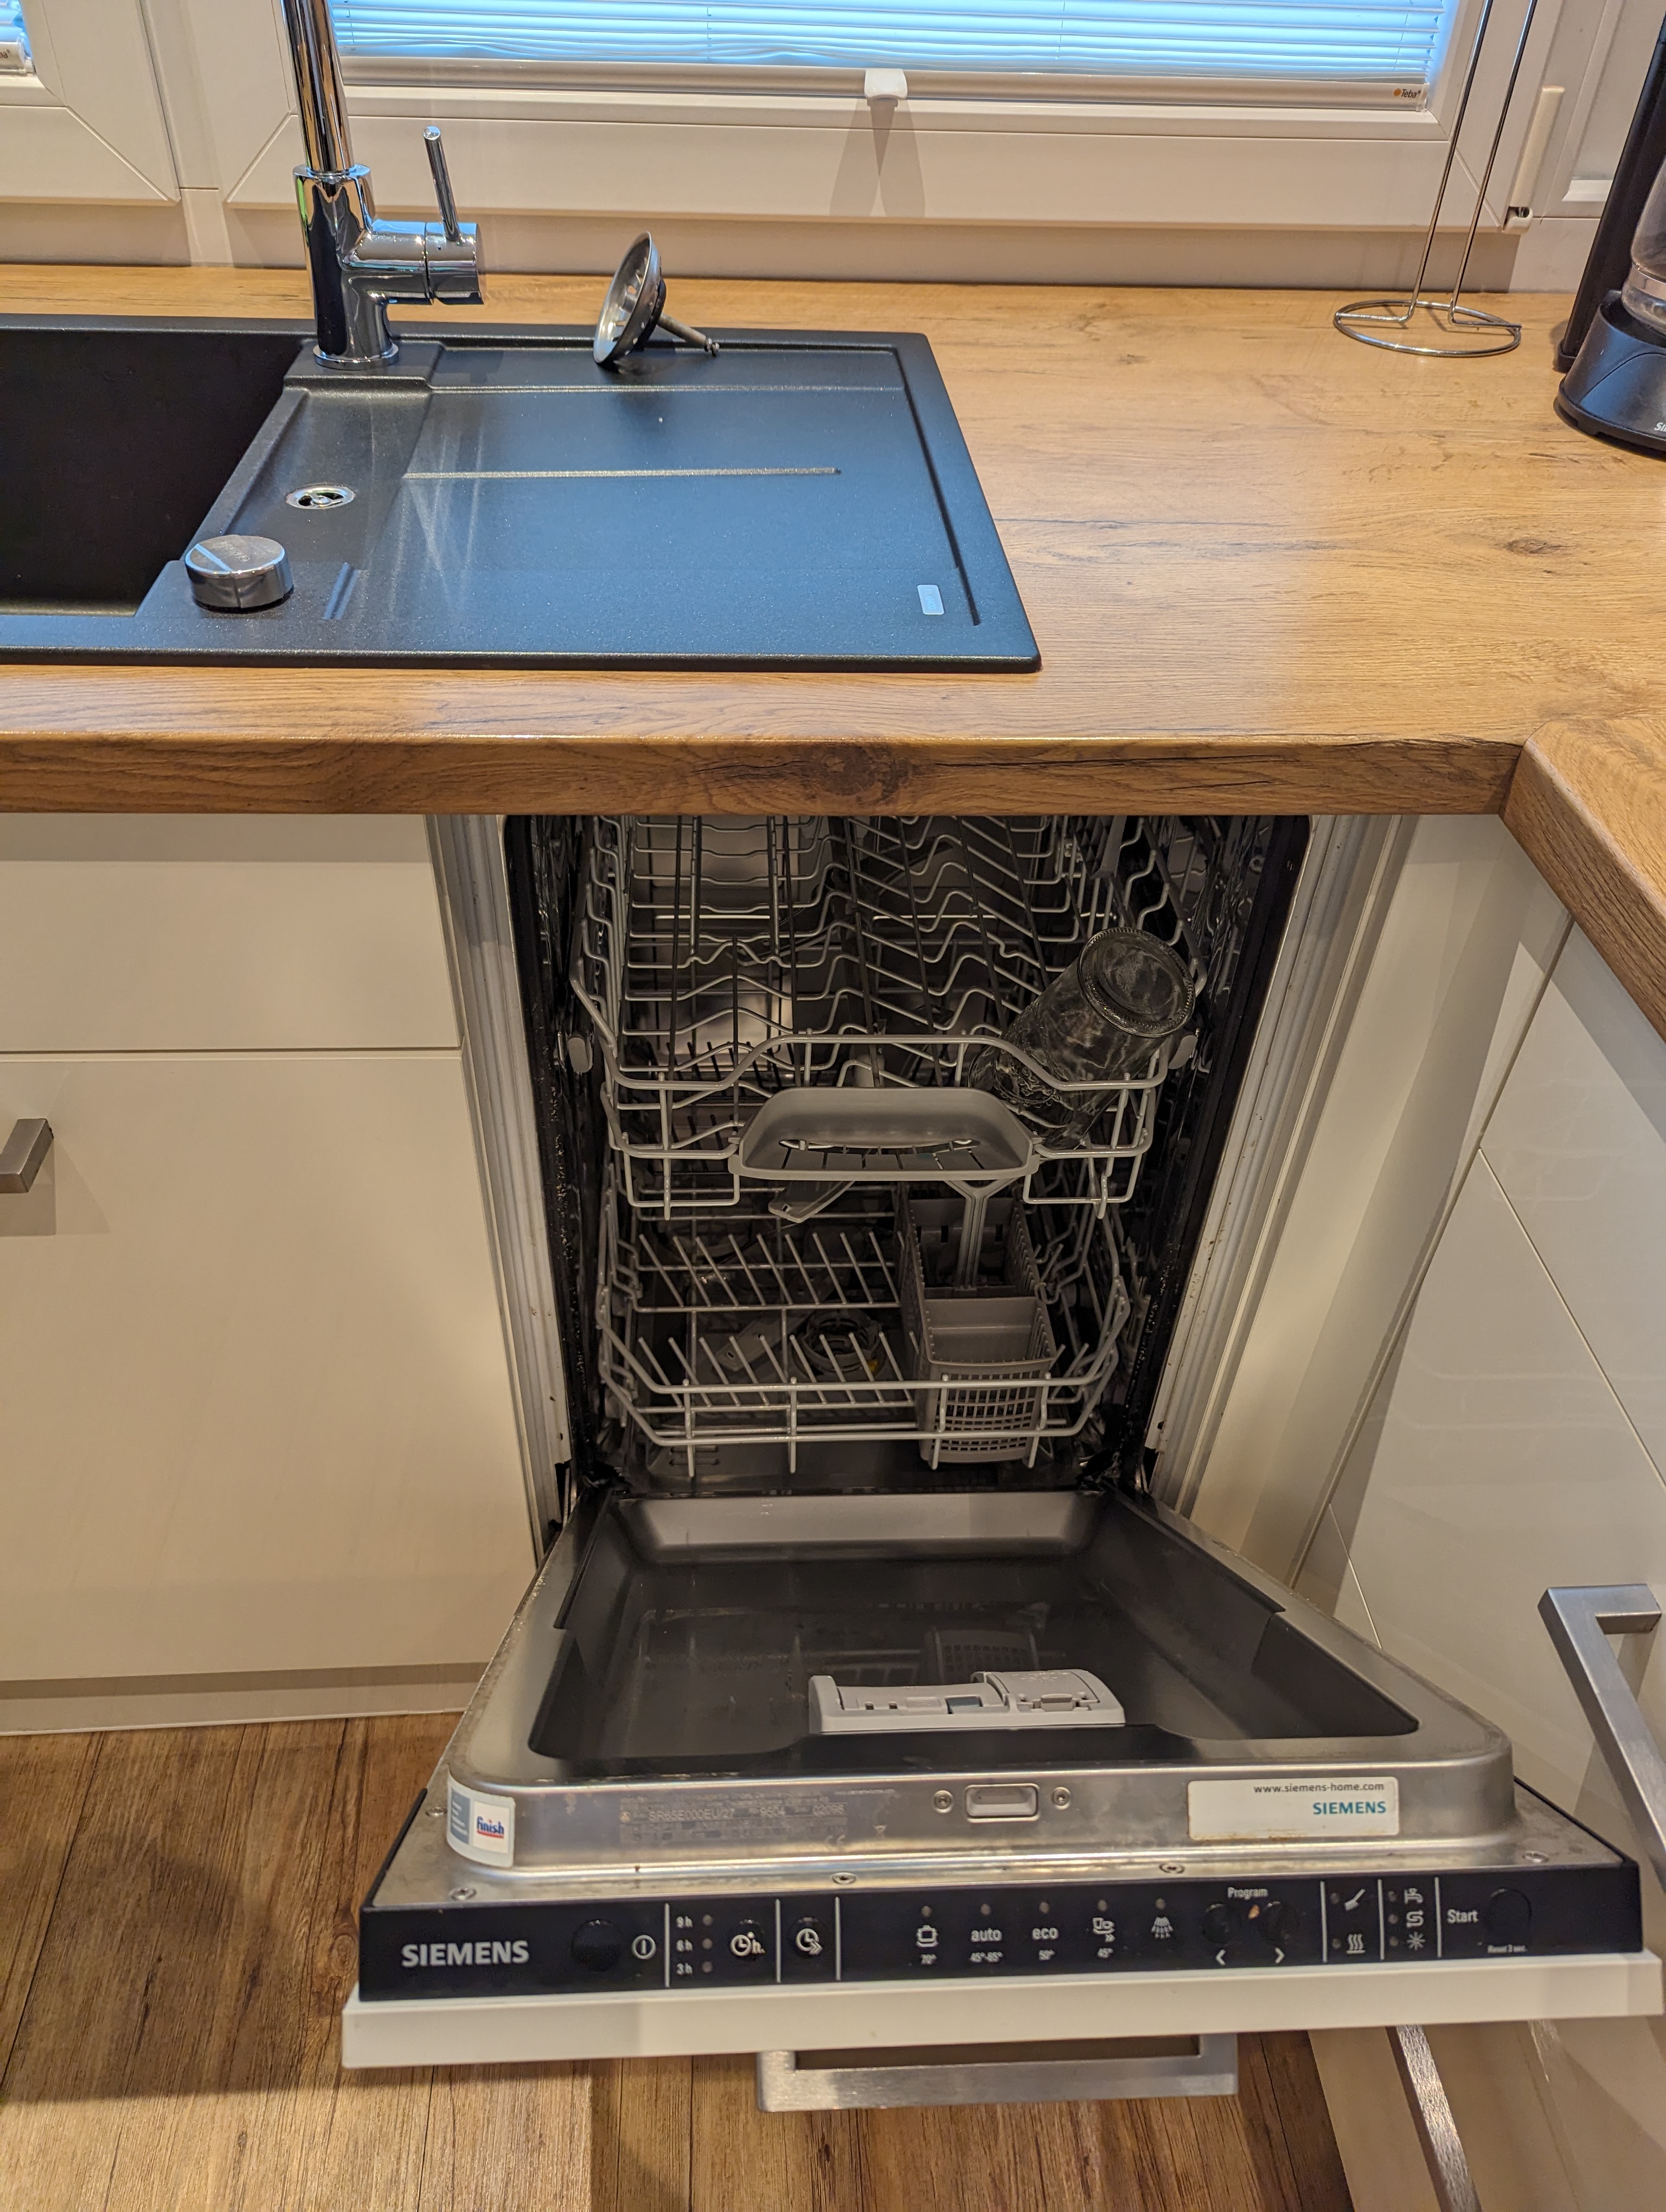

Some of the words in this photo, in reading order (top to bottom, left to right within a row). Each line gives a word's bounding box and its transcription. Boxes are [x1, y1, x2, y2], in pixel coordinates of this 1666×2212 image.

[1254, 1782, 1384, 1793] www.siemens-home.com
[1313, 1801, 1387, 1815] SIEMENS
[477, 1816, 504, 1835] finish
[1228, 1887, 1268, 1900] Program
[1447, 1909, 1478, 1924] Start
[971, 1928, 1002, 1942] auto
[1032, 1927, 1058, 1940] eco
[401, 1940, 530, 1969] SIEMENS
